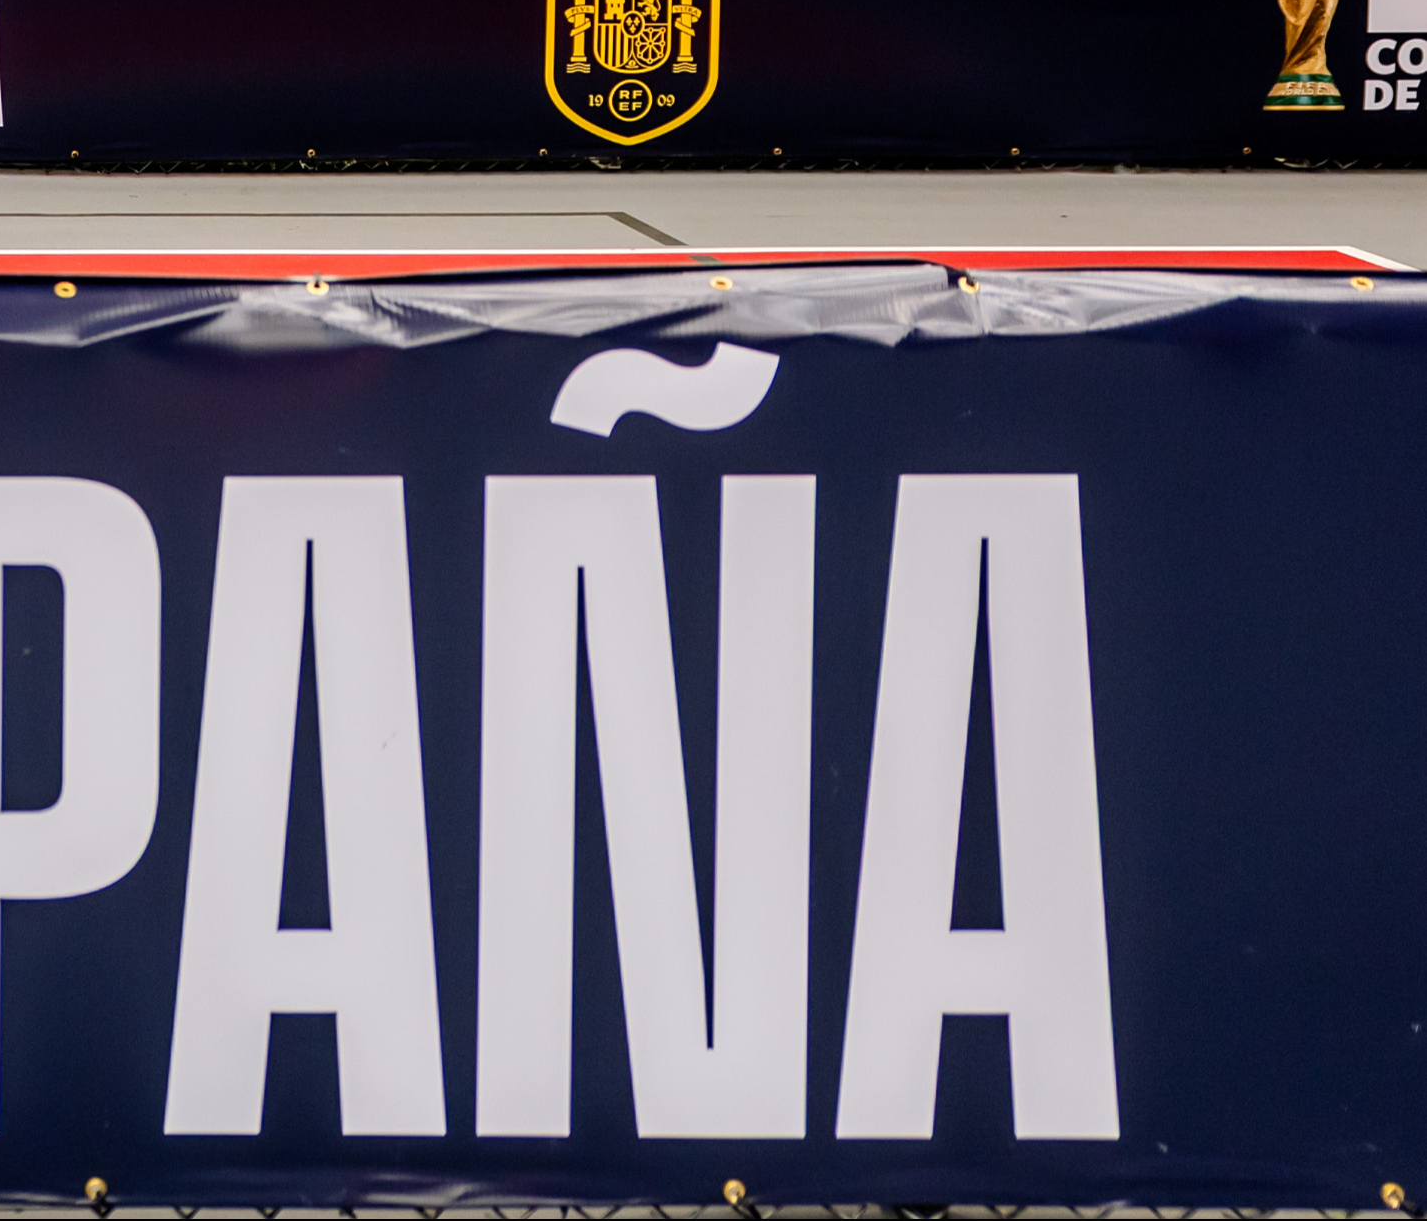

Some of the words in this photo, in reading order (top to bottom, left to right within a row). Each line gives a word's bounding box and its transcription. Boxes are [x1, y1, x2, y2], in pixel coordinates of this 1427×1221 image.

[588, 94, 604, 107] 19
[657, 94, 675, 107] 09
[1363, 79, 1421, 111] DE
